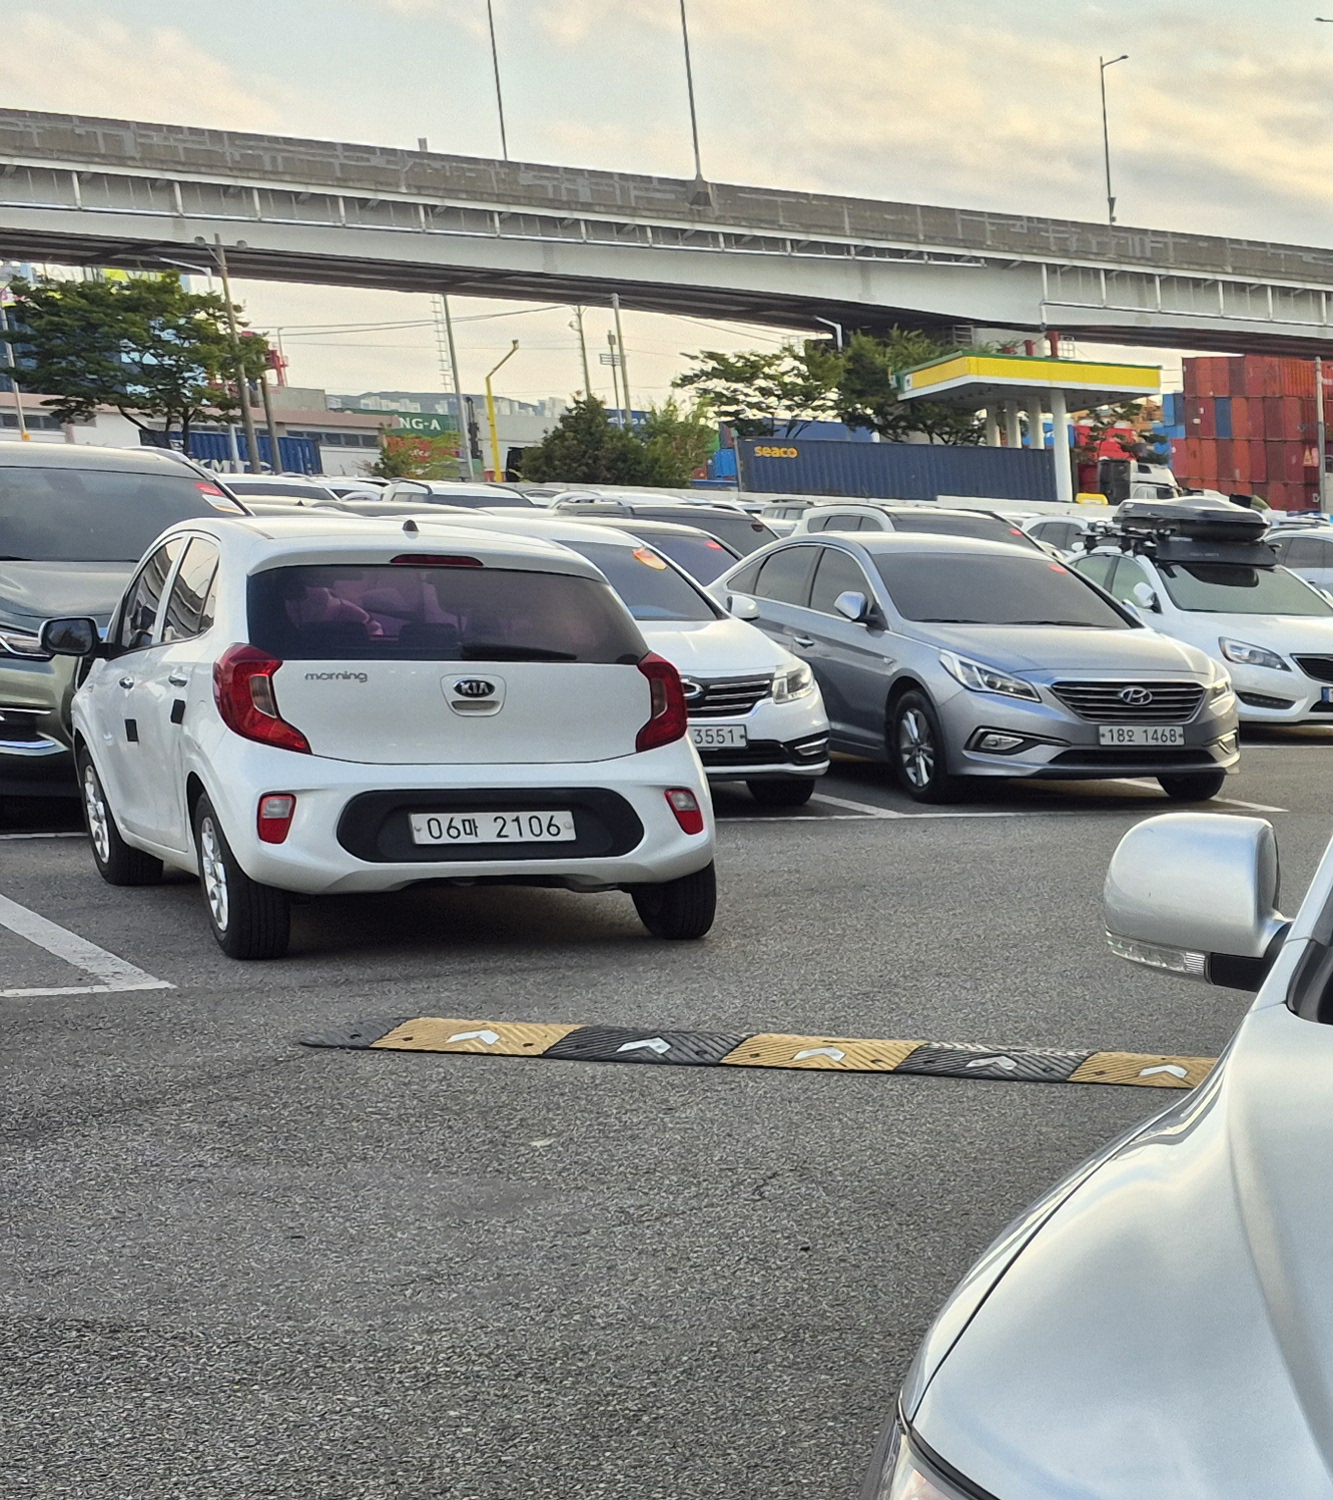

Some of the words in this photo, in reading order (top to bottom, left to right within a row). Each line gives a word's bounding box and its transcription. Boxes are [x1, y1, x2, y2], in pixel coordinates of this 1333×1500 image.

[399, 417, 441, 431] NG-A
[754, 444, 798, 458] seaco
[304, 671, 368, 683] morning
[460, 681, 490, 695] KIA
[693, 727, 735, 744] 3551
[1142, 728, 1177, 744] 1468
[426, 817, 479, 840] 06마
[493, 815, 561, 838] 2106
